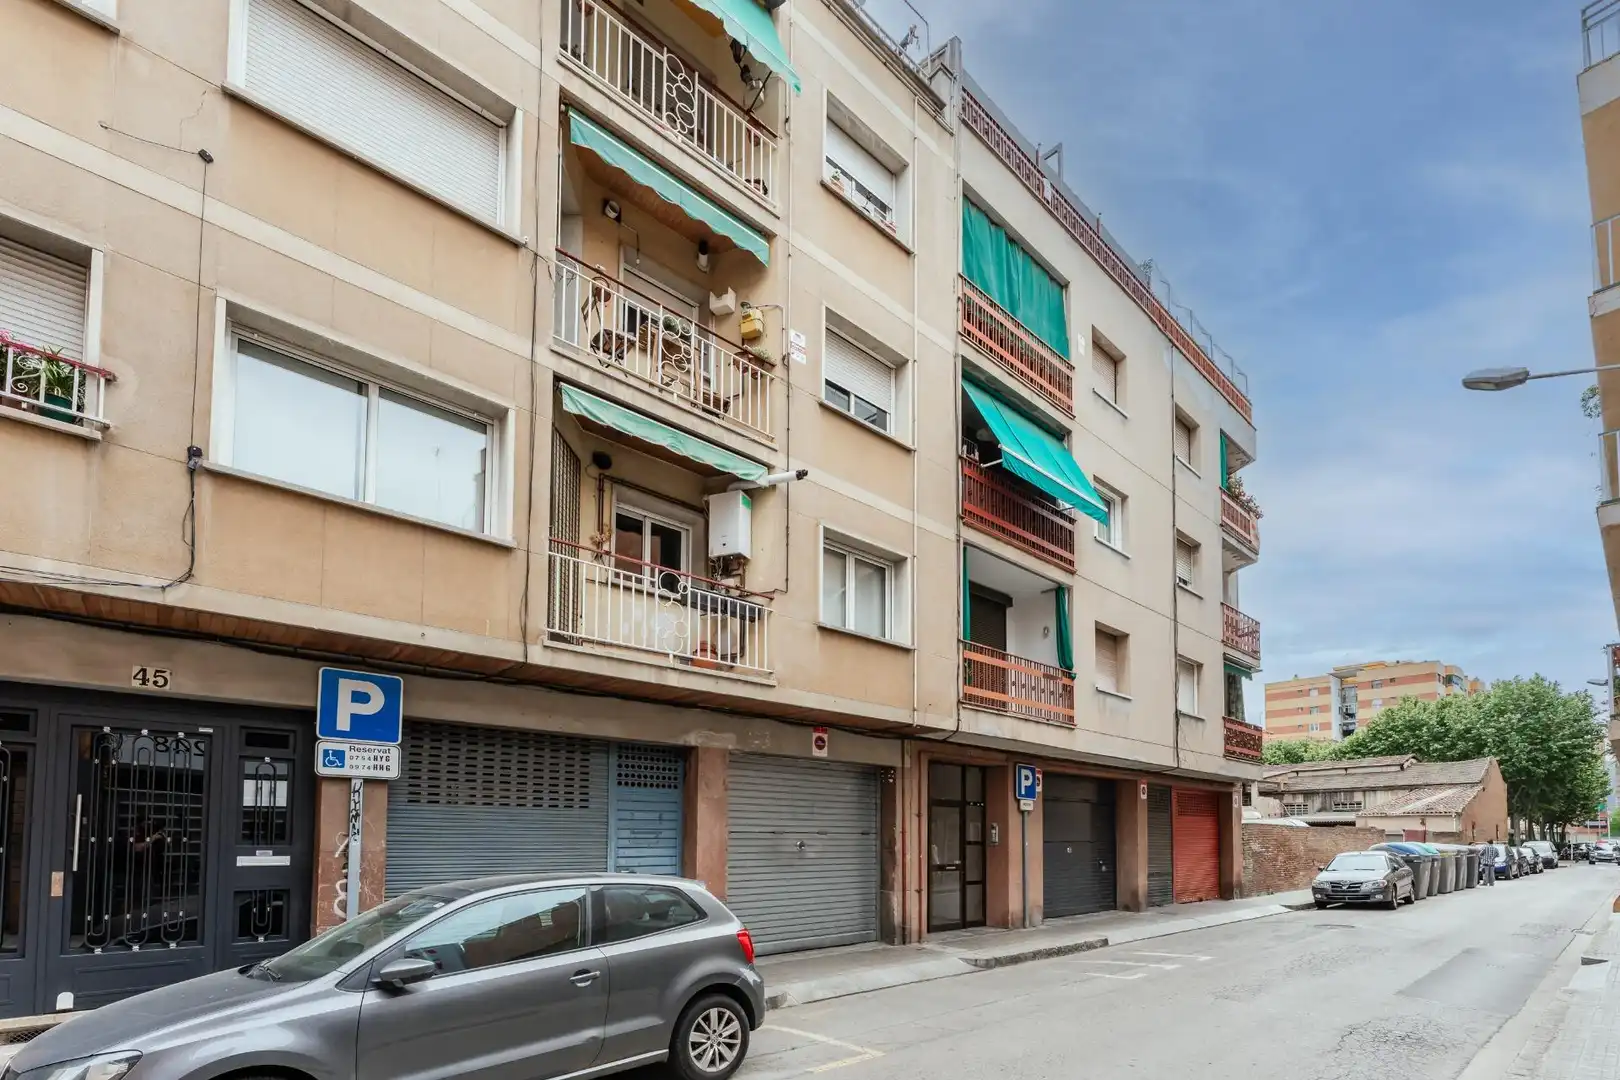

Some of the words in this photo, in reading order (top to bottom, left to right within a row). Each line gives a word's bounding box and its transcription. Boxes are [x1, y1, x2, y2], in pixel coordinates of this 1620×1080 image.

[133, 668, 169, 688] 45
[336, 678, 386, 731] P
[349, 745, 391, 754] Reservat
[1021, 768, 1033, 795] P
